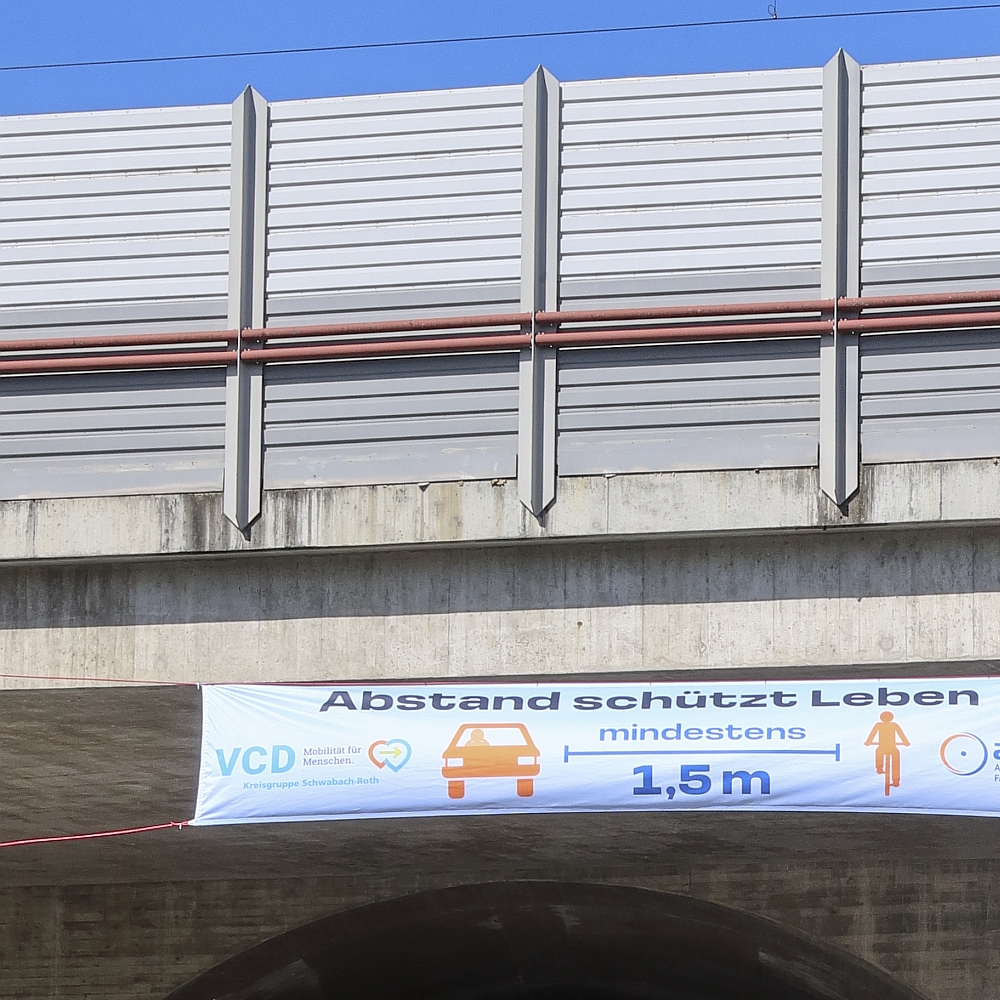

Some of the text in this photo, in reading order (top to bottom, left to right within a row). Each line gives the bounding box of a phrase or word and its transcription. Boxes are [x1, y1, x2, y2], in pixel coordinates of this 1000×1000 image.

[319, 687, 979, 712] Abstand schützt Leben
[600, 723, 806, 741] mindestens
[303, 746, 362, 756] Mobilität für
[215, 745, 296, 777] VCD
[303, 757, 354, 766] Menschen.
[243, 776, 379, 790] Kreisgruppe Schwabach-Roth
[633, 764, 770, 800] 1,5 m
